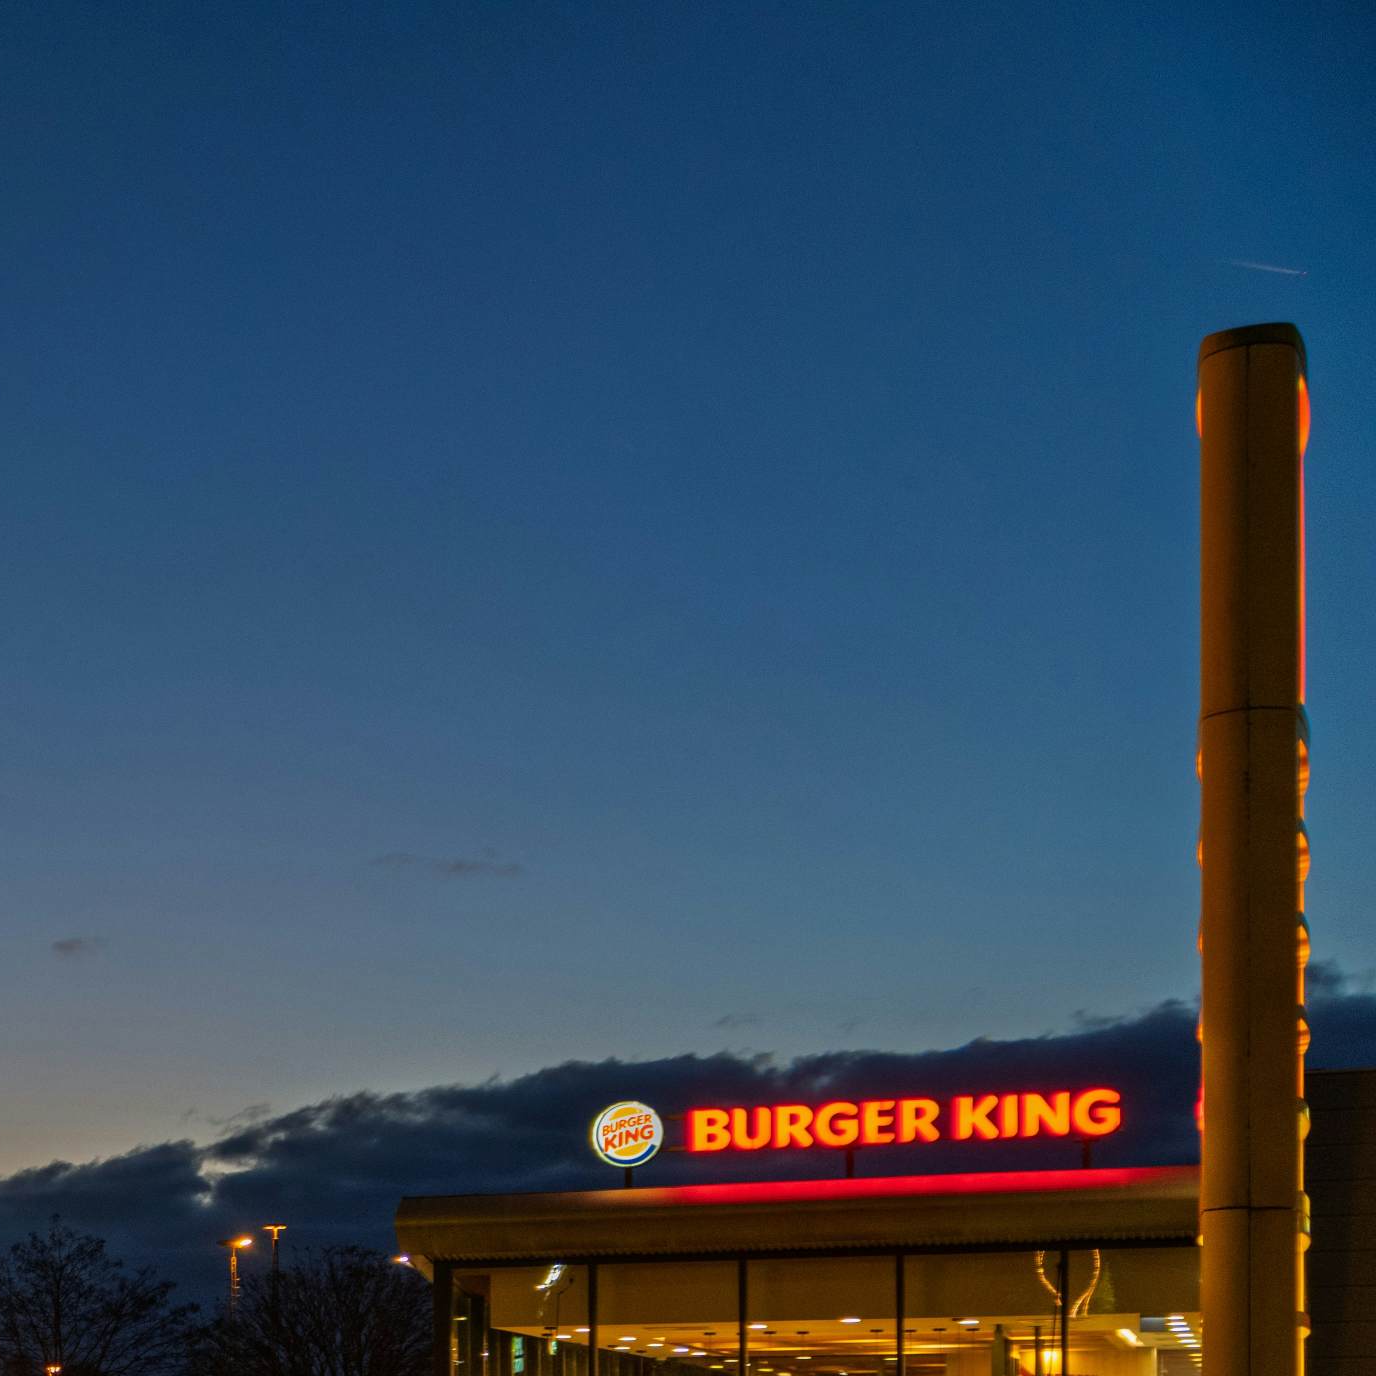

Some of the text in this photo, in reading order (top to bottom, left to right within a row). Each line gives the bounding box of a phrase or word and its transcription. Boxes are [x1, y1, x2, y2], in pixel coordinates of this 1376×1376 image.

[602, 1114, 652, 1136] BURGER
[691, 1089, 1121, 1152] BURGER KING
[604, 1125, 655, 1152] KING
